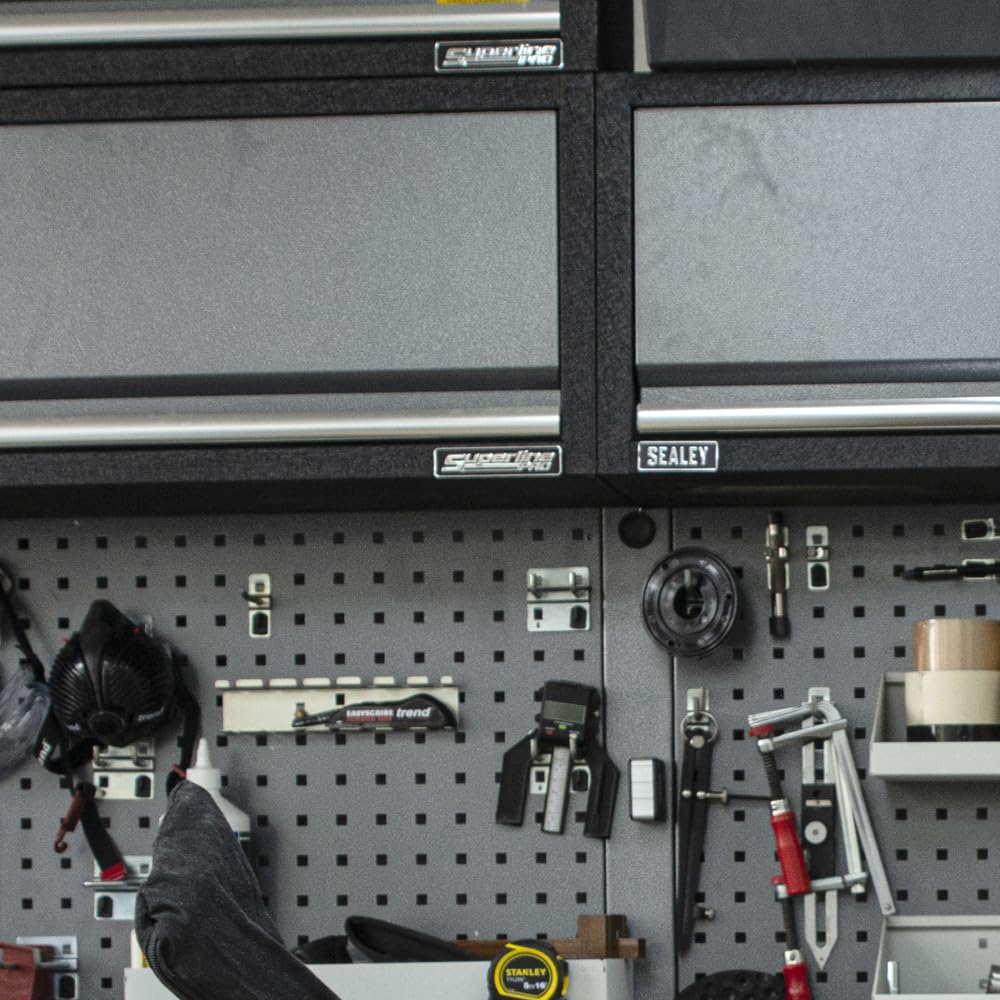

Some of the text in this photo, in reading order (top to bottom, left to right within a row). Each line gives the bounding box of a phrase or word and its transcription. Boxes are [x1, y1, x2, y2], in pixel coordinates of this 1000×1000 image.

[441, 450, 556, 473] Superline
[647, 446, 709, 466] SEALEY
[396, 707, 431, 718] trend
[505, 968, 546, 977] STANLEY
